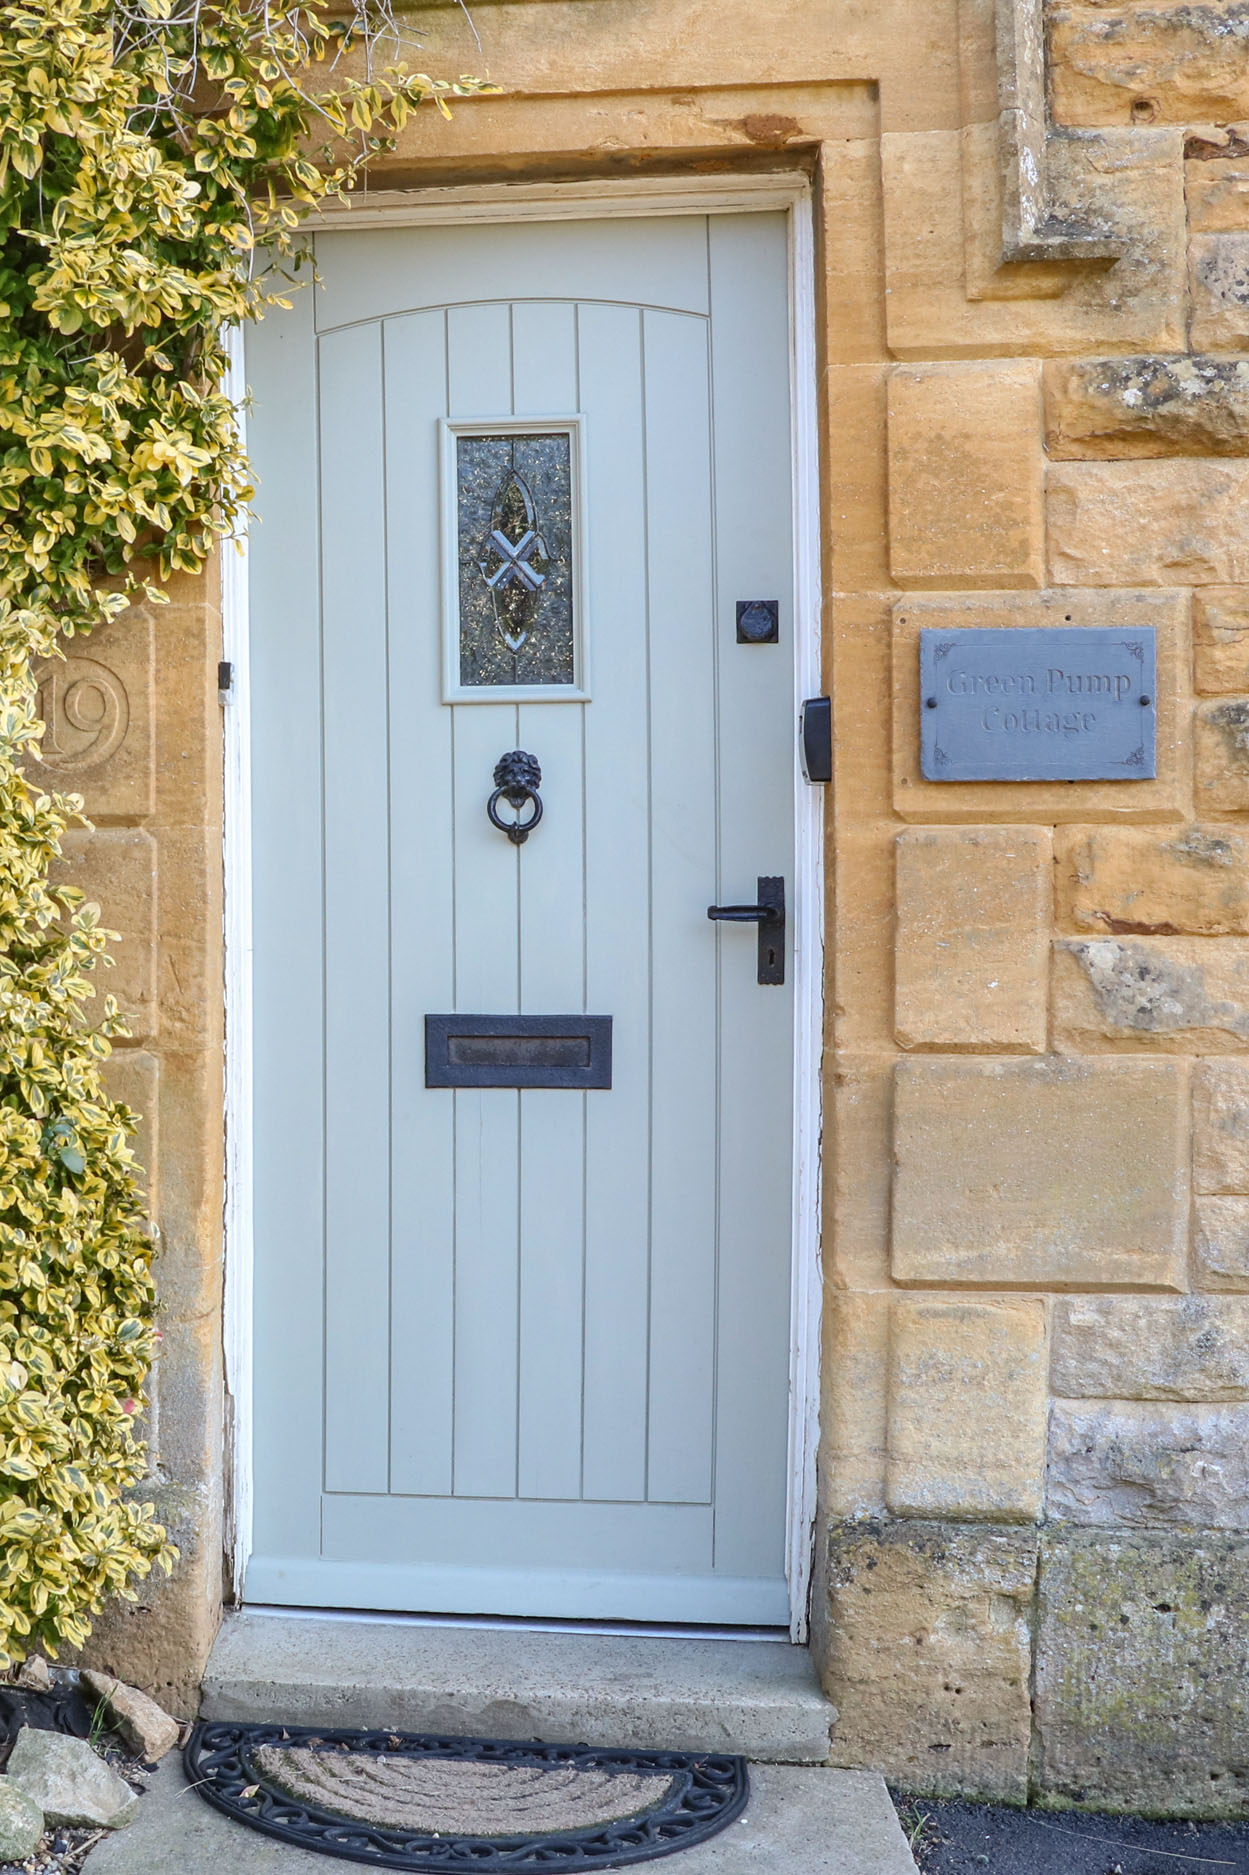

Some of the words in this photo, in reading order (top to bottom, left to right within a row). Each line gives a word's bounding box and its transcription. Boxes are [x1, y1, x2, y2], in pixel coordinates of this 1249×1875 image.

[946, 668, 1035, 696] Green
[1047, 668, 1132, 701] Pump
[980, 705, 1097, 735] Cottage
